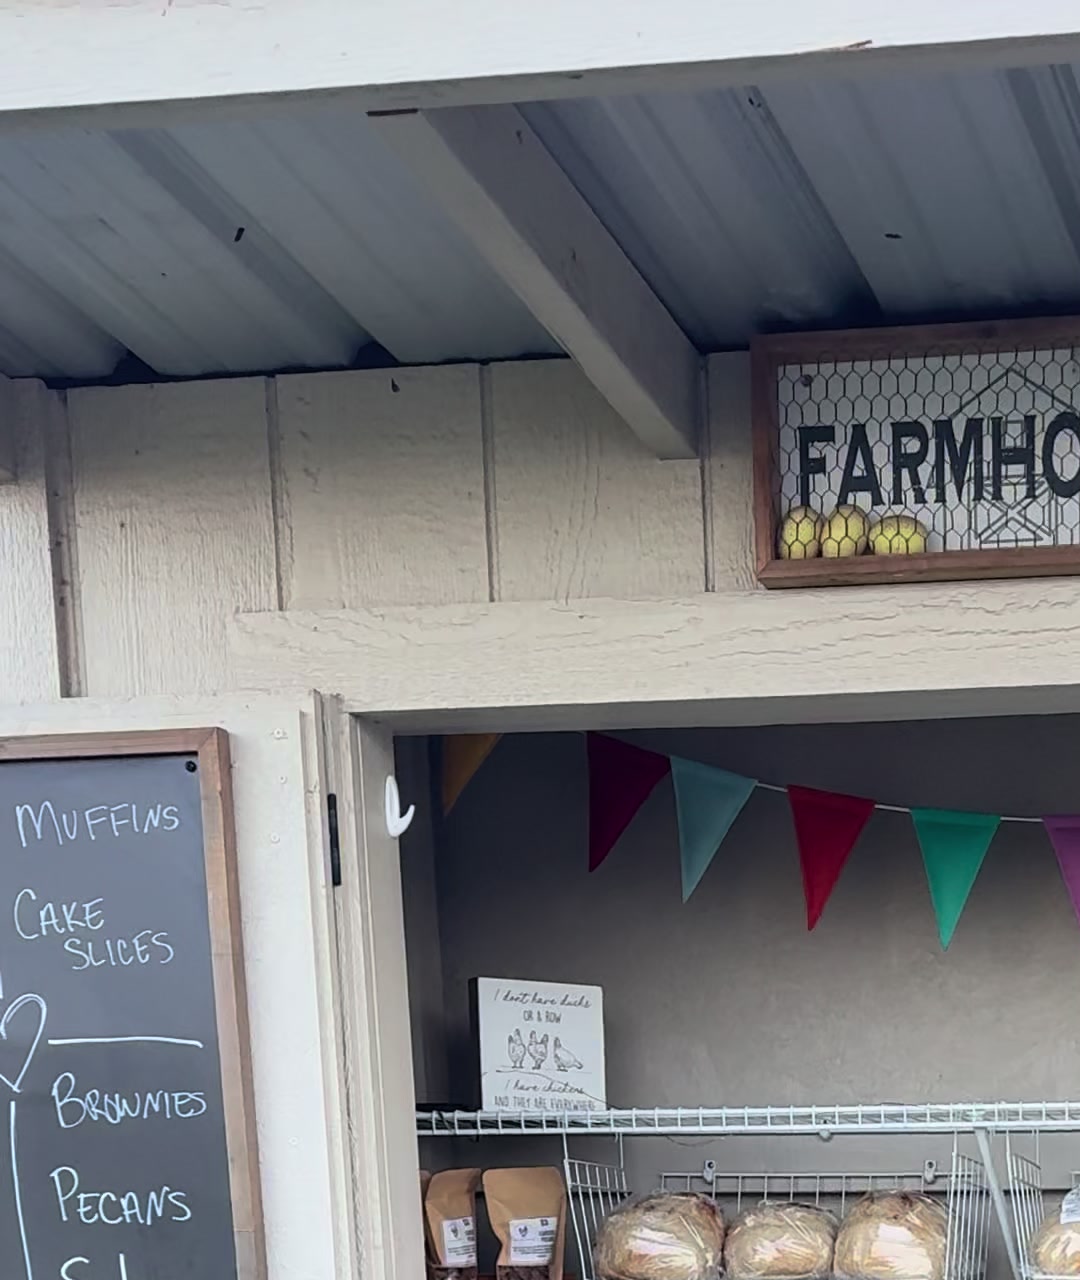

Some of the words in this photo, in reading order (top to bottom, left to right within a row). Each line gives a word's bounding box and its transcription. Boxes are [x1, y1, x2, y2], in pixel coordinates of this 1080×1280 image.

[15, 800, 180, 848] MUFFINS
[13, 888, 105, 939] CAKE
[63, 929, 175, 970] SLICES
[52, 1072, 207, 1129] BROWNIES
[49, 1166, 192, 1226] PECANS
